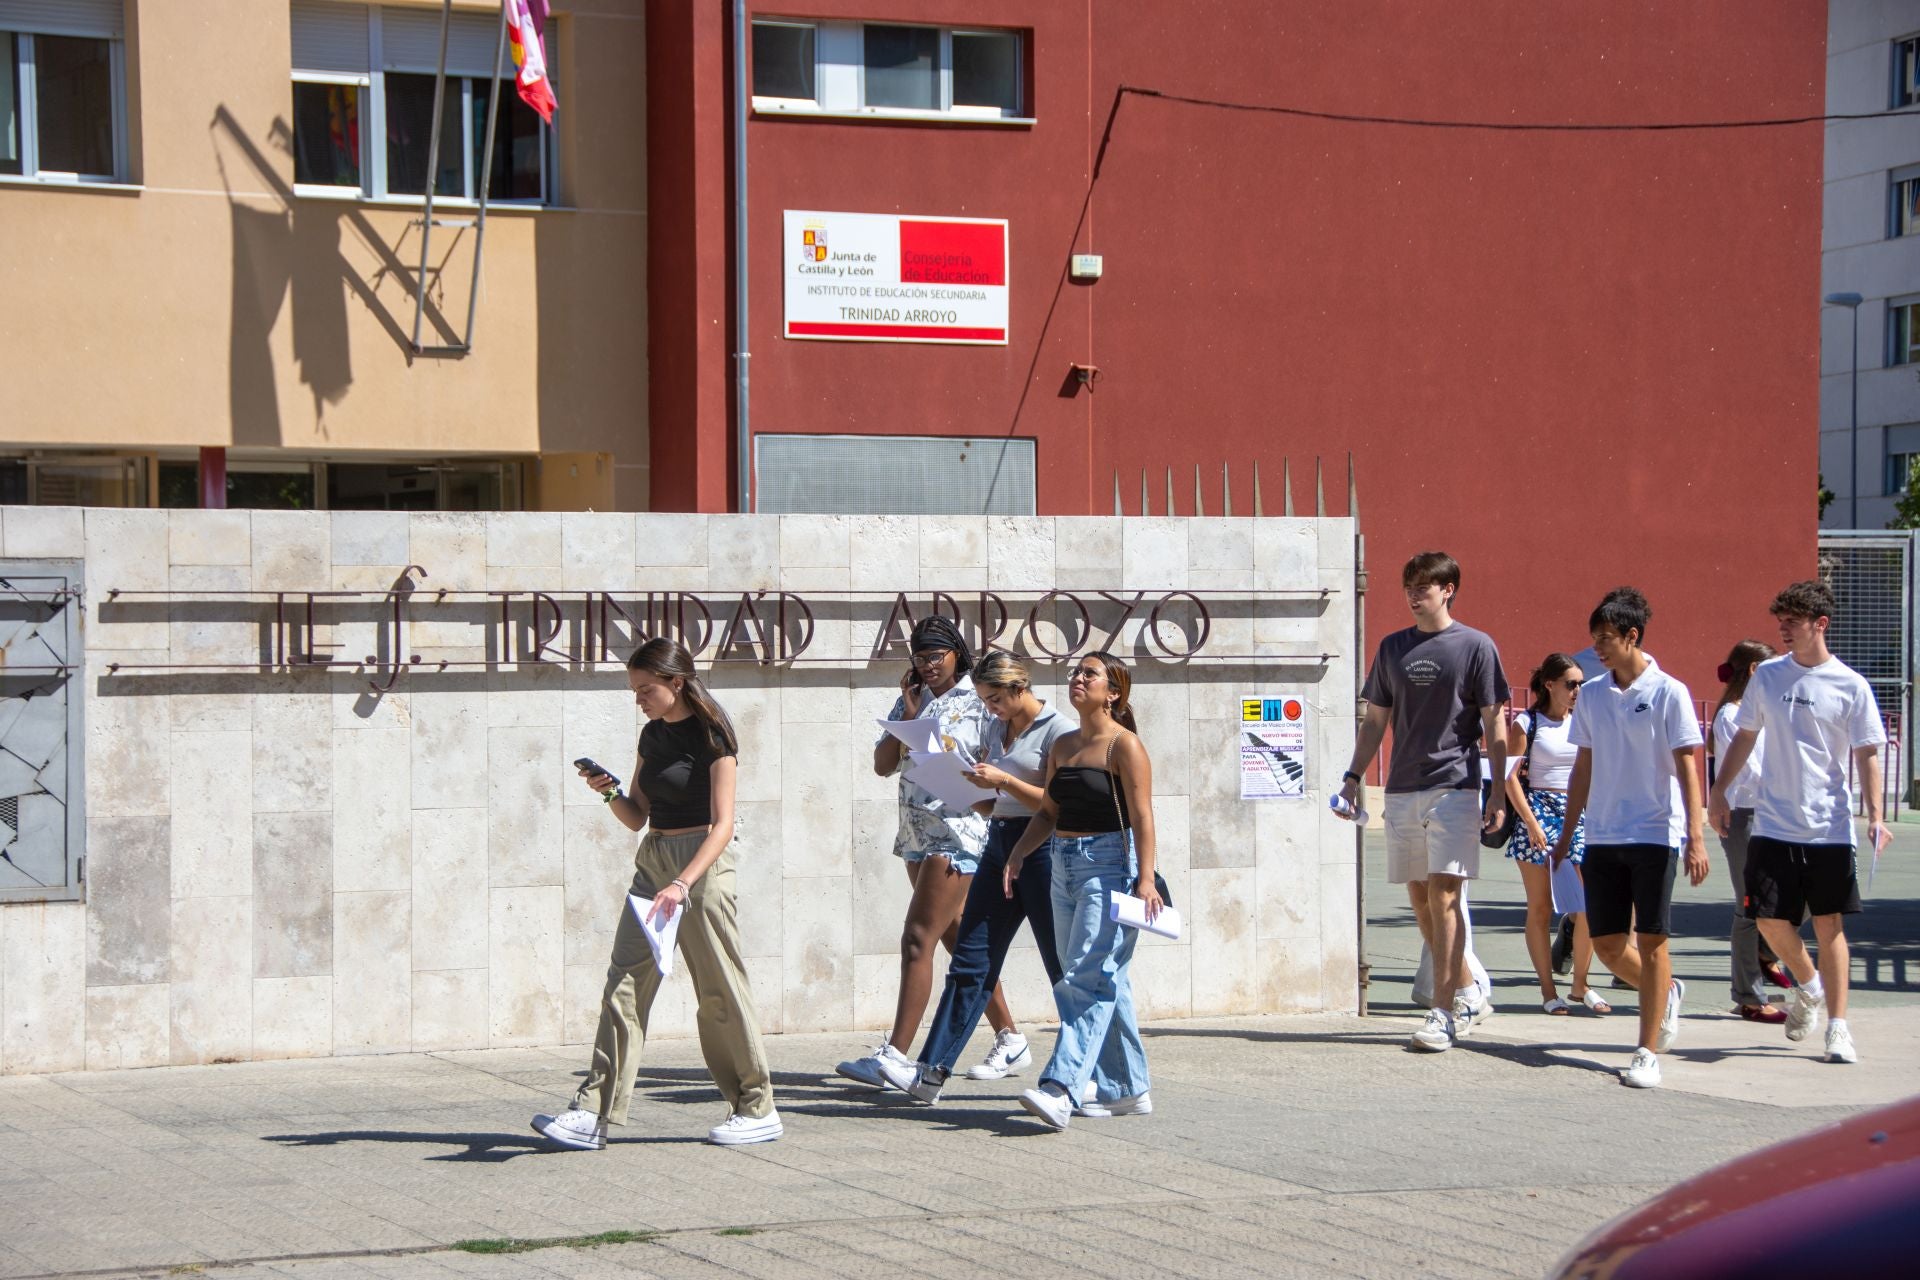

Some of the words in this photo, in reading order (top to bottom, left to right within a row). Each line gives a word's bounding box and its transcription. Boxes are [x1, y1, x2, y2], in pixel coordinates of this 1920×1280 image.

[830, 251, 861, 262] Junta
[863, 252, 877, 262] de
[798, 263, 836, 275] Castilla
[838, 267, 845, 277] y
[847, 265, 874, 276] León
[904, 267, 920, 281] de
[925, 267, 989, 283] Educación
[807, 285, 857, 296] INSTITUTO
[860, 287, 871, 297] DE
[874, 286, 928, 299] EDUCACIÓN
[930, 289, 987, 301] SECUNDARIA
[840, 306, 900, 321] TRINIDAD
[904, 309, 957, 323] ARROYO
[488, 590, 815, 662] TRINIDAD
